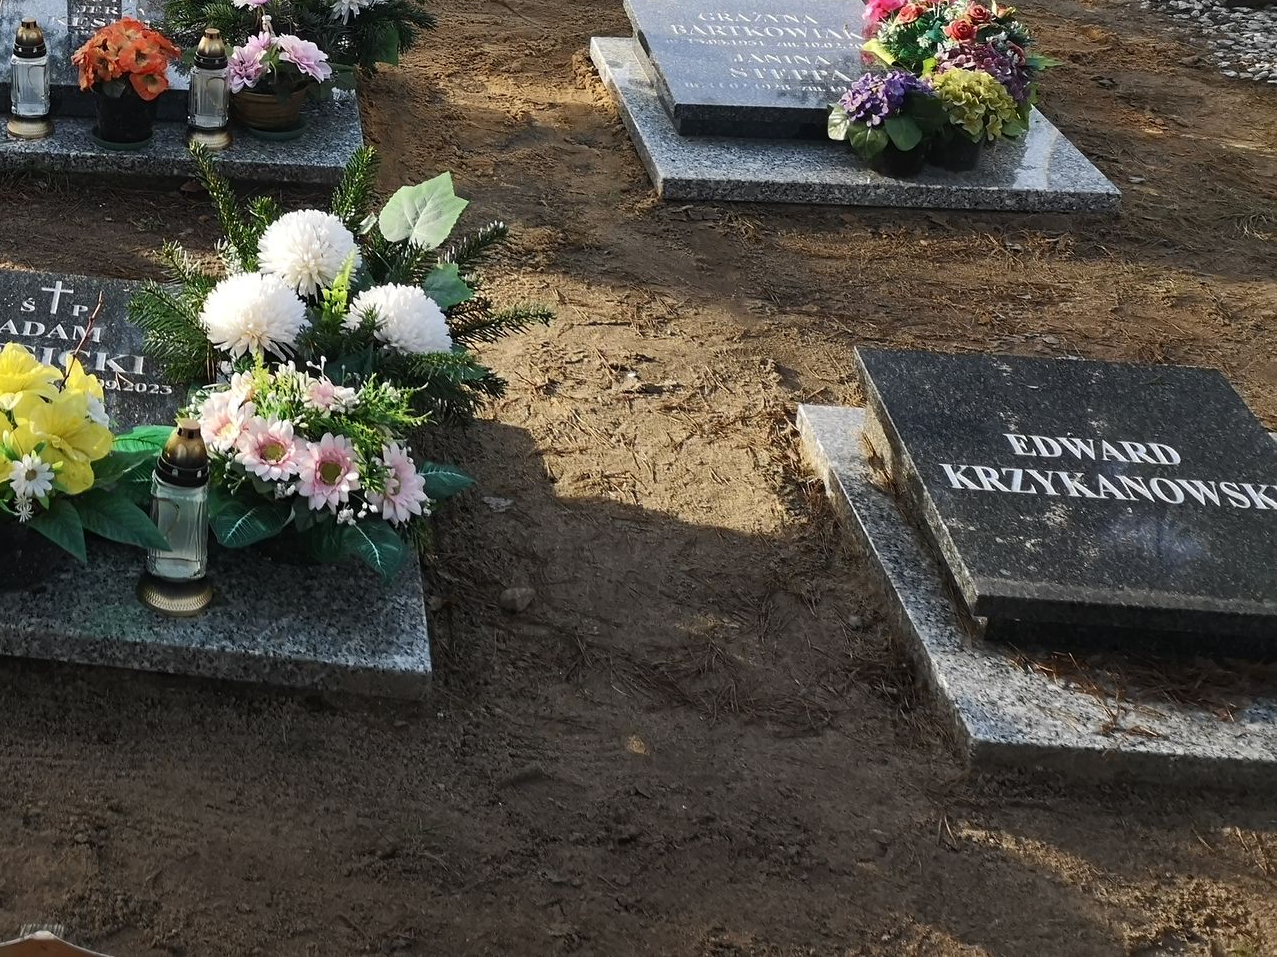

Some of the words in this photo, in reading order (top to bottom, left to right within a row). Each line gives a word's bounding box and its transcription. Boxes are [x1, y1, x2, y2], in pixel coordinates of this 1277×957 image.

[698, 11, 819, 25] GRAŻYNA
[670, 24, 865, 40] BARTKOWIAK
[733, 53, 832, 65] JANINA
[72, 304, 89, 317] P
[1003, 433, 1181, 466] EDWARD
[939, 463, 1277, 510] KRZYKANOWSK
